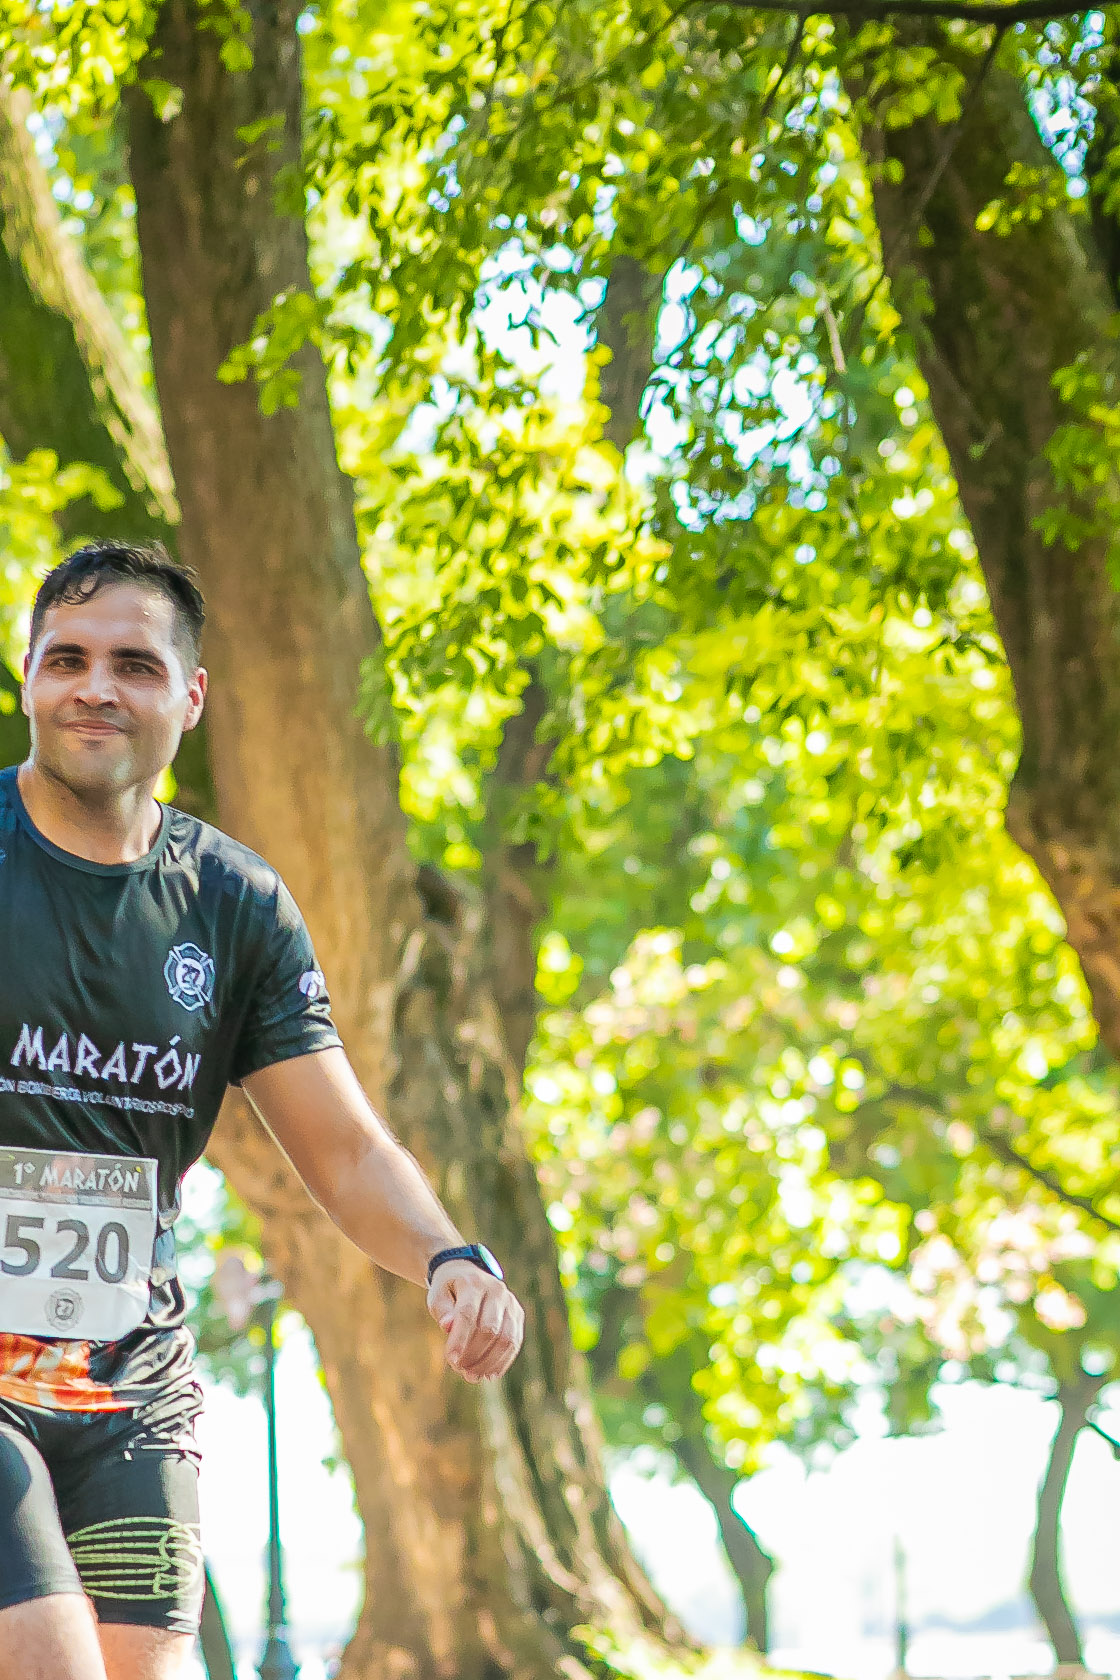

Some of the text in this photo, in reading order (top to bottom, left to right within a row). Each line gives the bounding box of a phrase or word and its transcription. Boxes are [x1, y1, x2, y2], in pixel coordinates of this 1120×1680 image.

[182, 963, 200, 985] 27
[10, 1022, 202, 1091] MARATÓN
[39, 1162, 140, 1193] MARATÓN
[0, 1213, 130, 1284] 520
